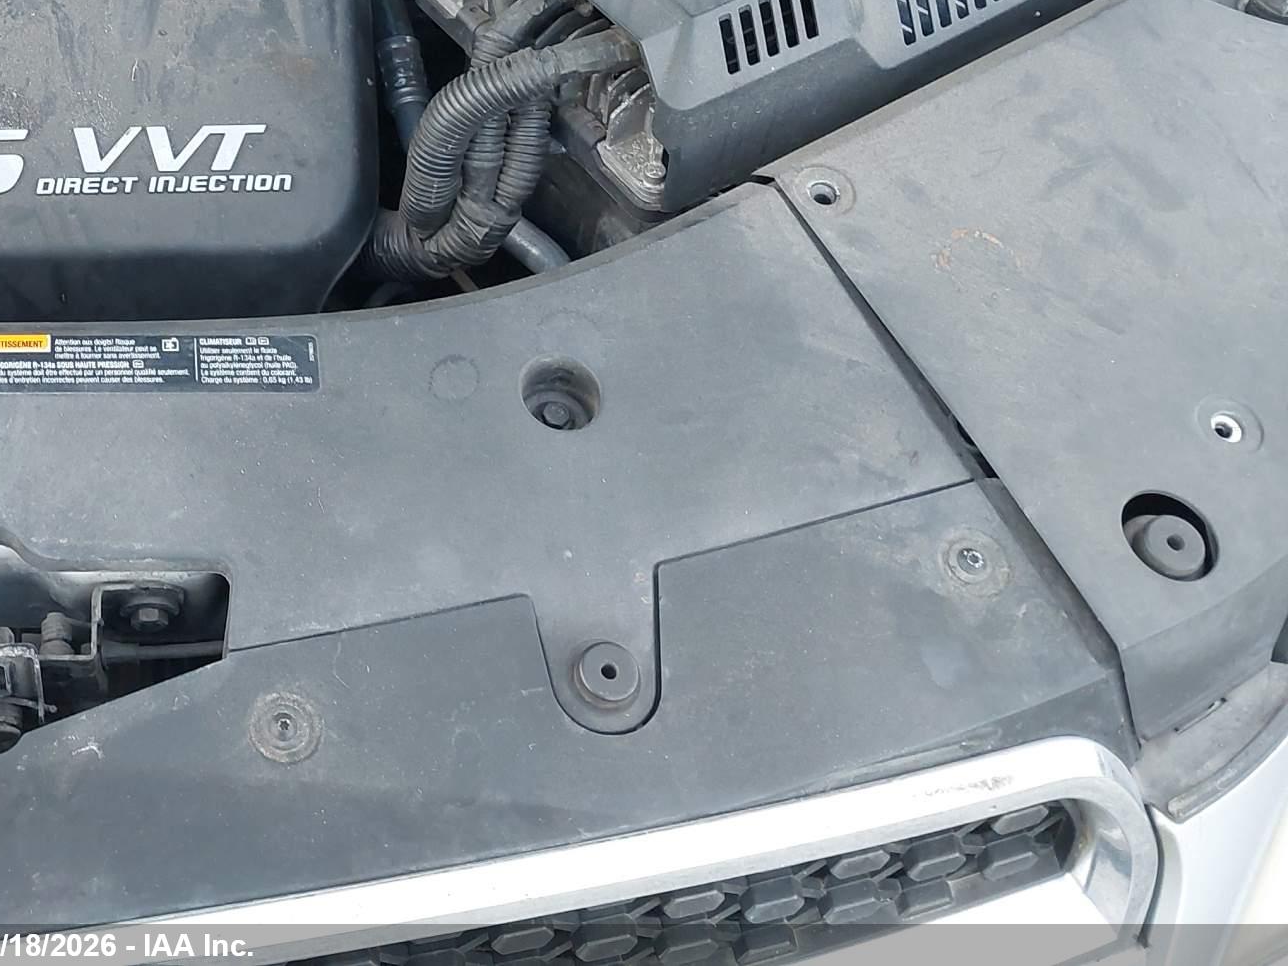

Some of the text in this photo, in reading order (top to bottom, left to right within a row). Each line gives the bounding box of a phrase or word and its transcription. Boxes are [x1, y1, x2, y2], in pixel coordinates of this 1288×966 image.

[72, 124, 267, 174] VVT
[35, 174, 292, 196] DIRECT INJECTION
